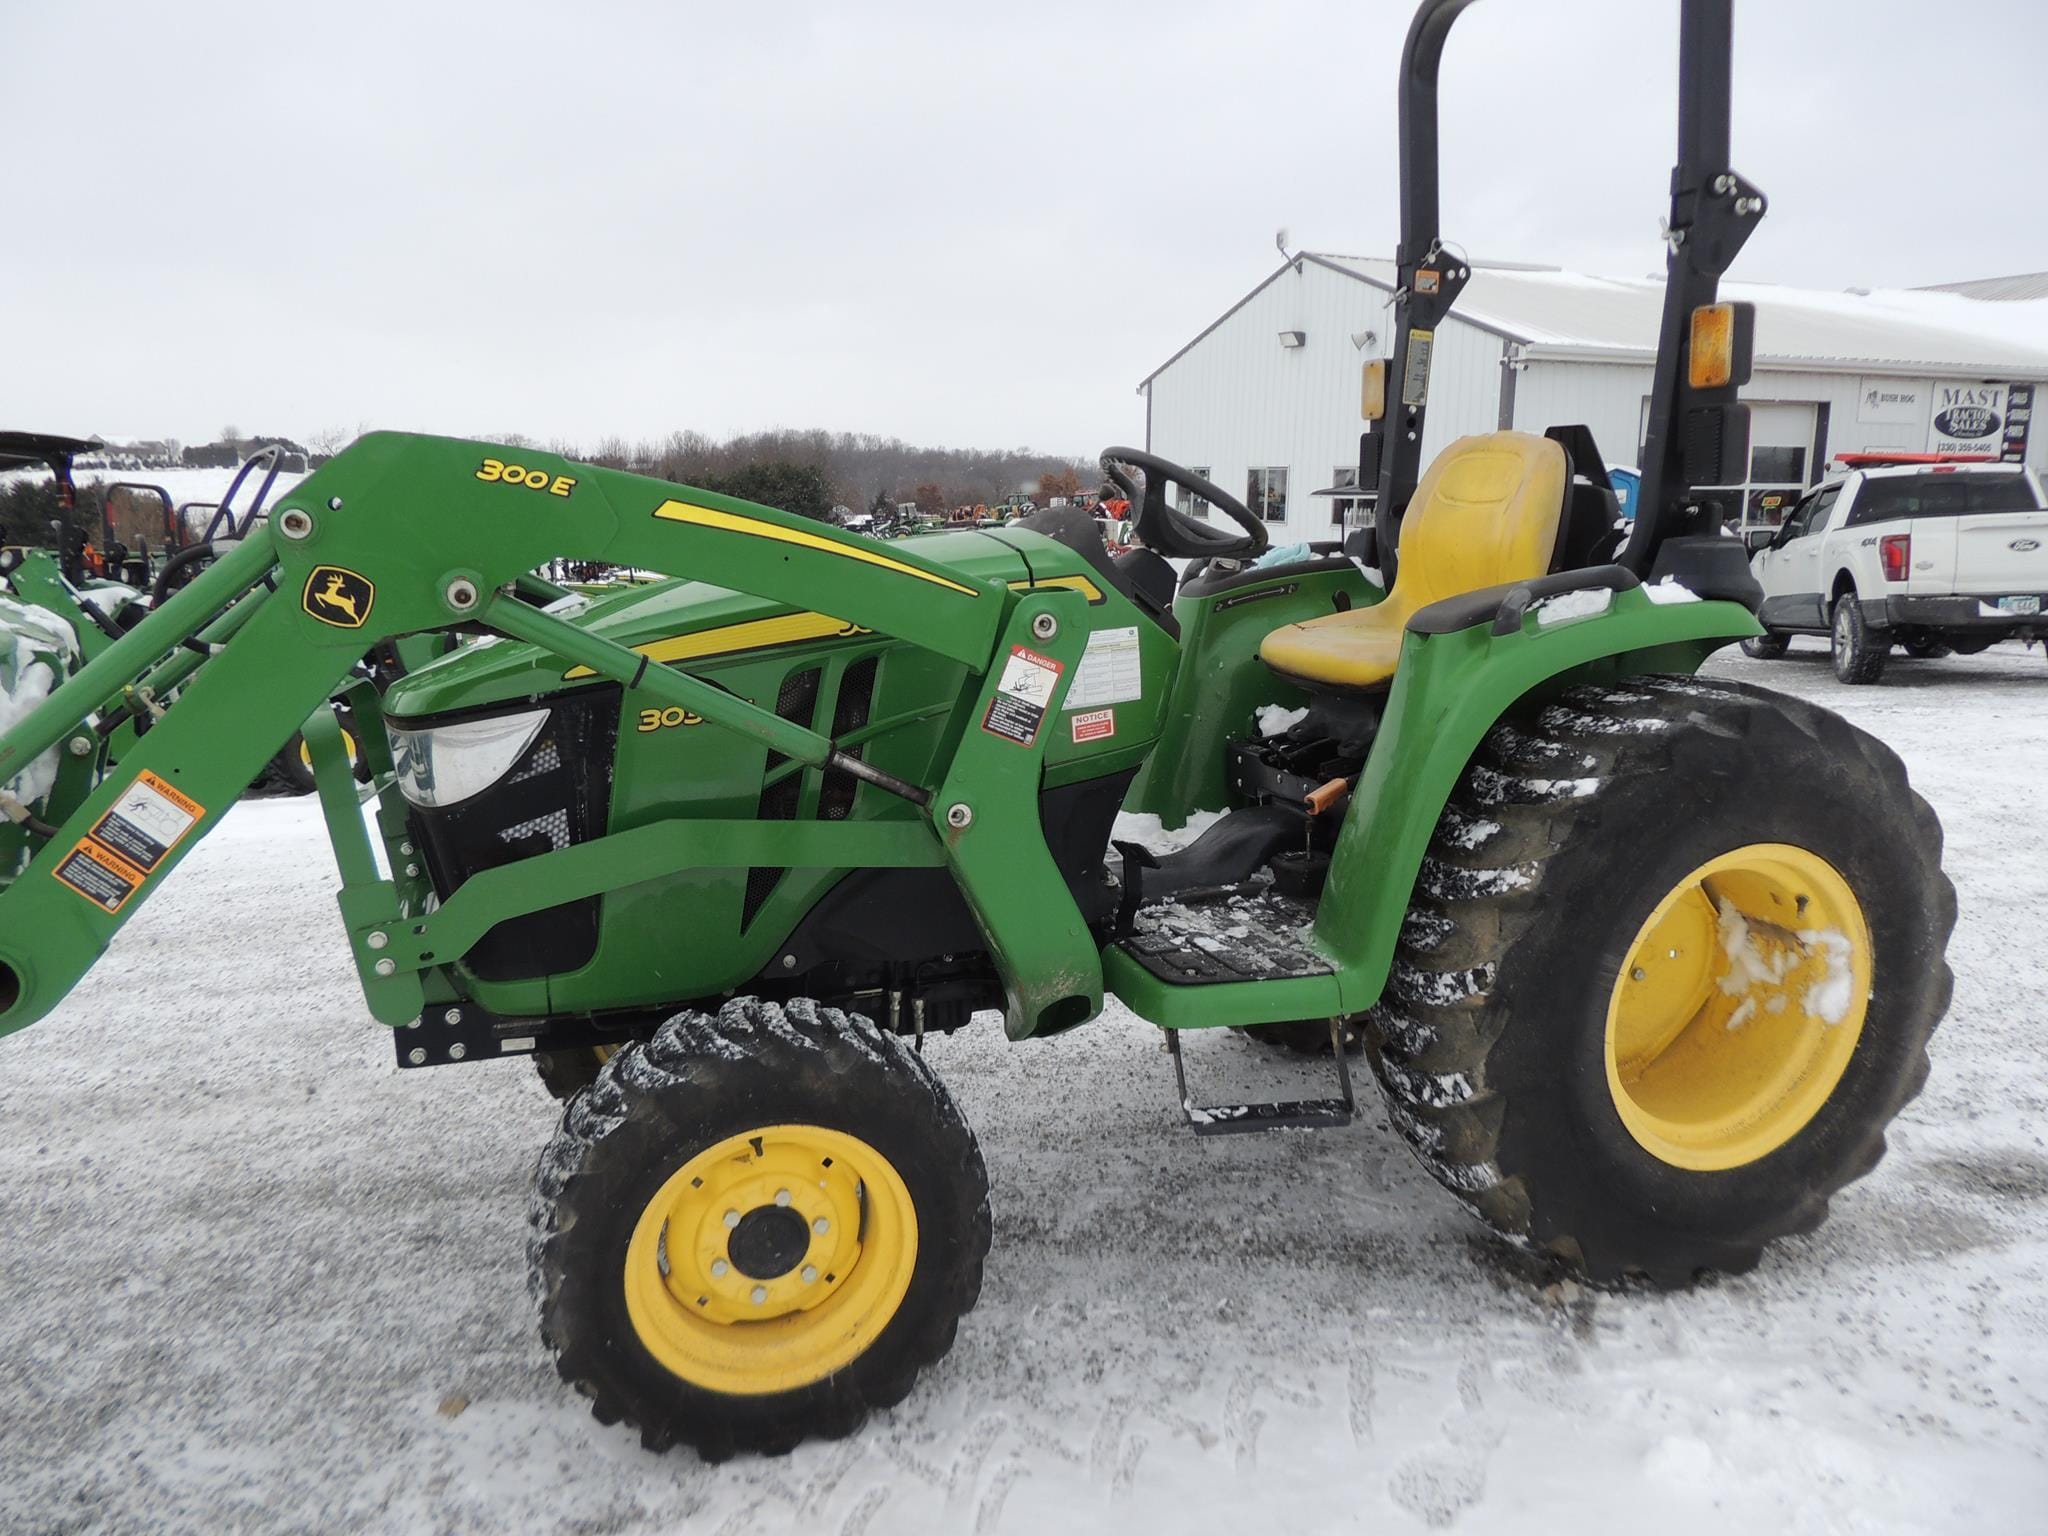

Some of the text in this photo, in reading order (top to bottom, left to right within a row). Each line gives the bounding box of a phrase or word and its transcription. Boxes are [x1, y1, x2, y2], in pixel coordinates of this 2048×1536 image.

[1941, 388, 2003, 408] MAST
[1945, 406, 1992, 421] TRACTOR
[1949, 418, 1987, 432] SALES
[2012, 539, 2038, 551] Ford
[1026, 653, 1057, 670] DANGER
[1076, 711, 1109, 724] NOTICE
[157, 783, 196, 813] WARNING
[95, 852, 136, 881] WARNING
